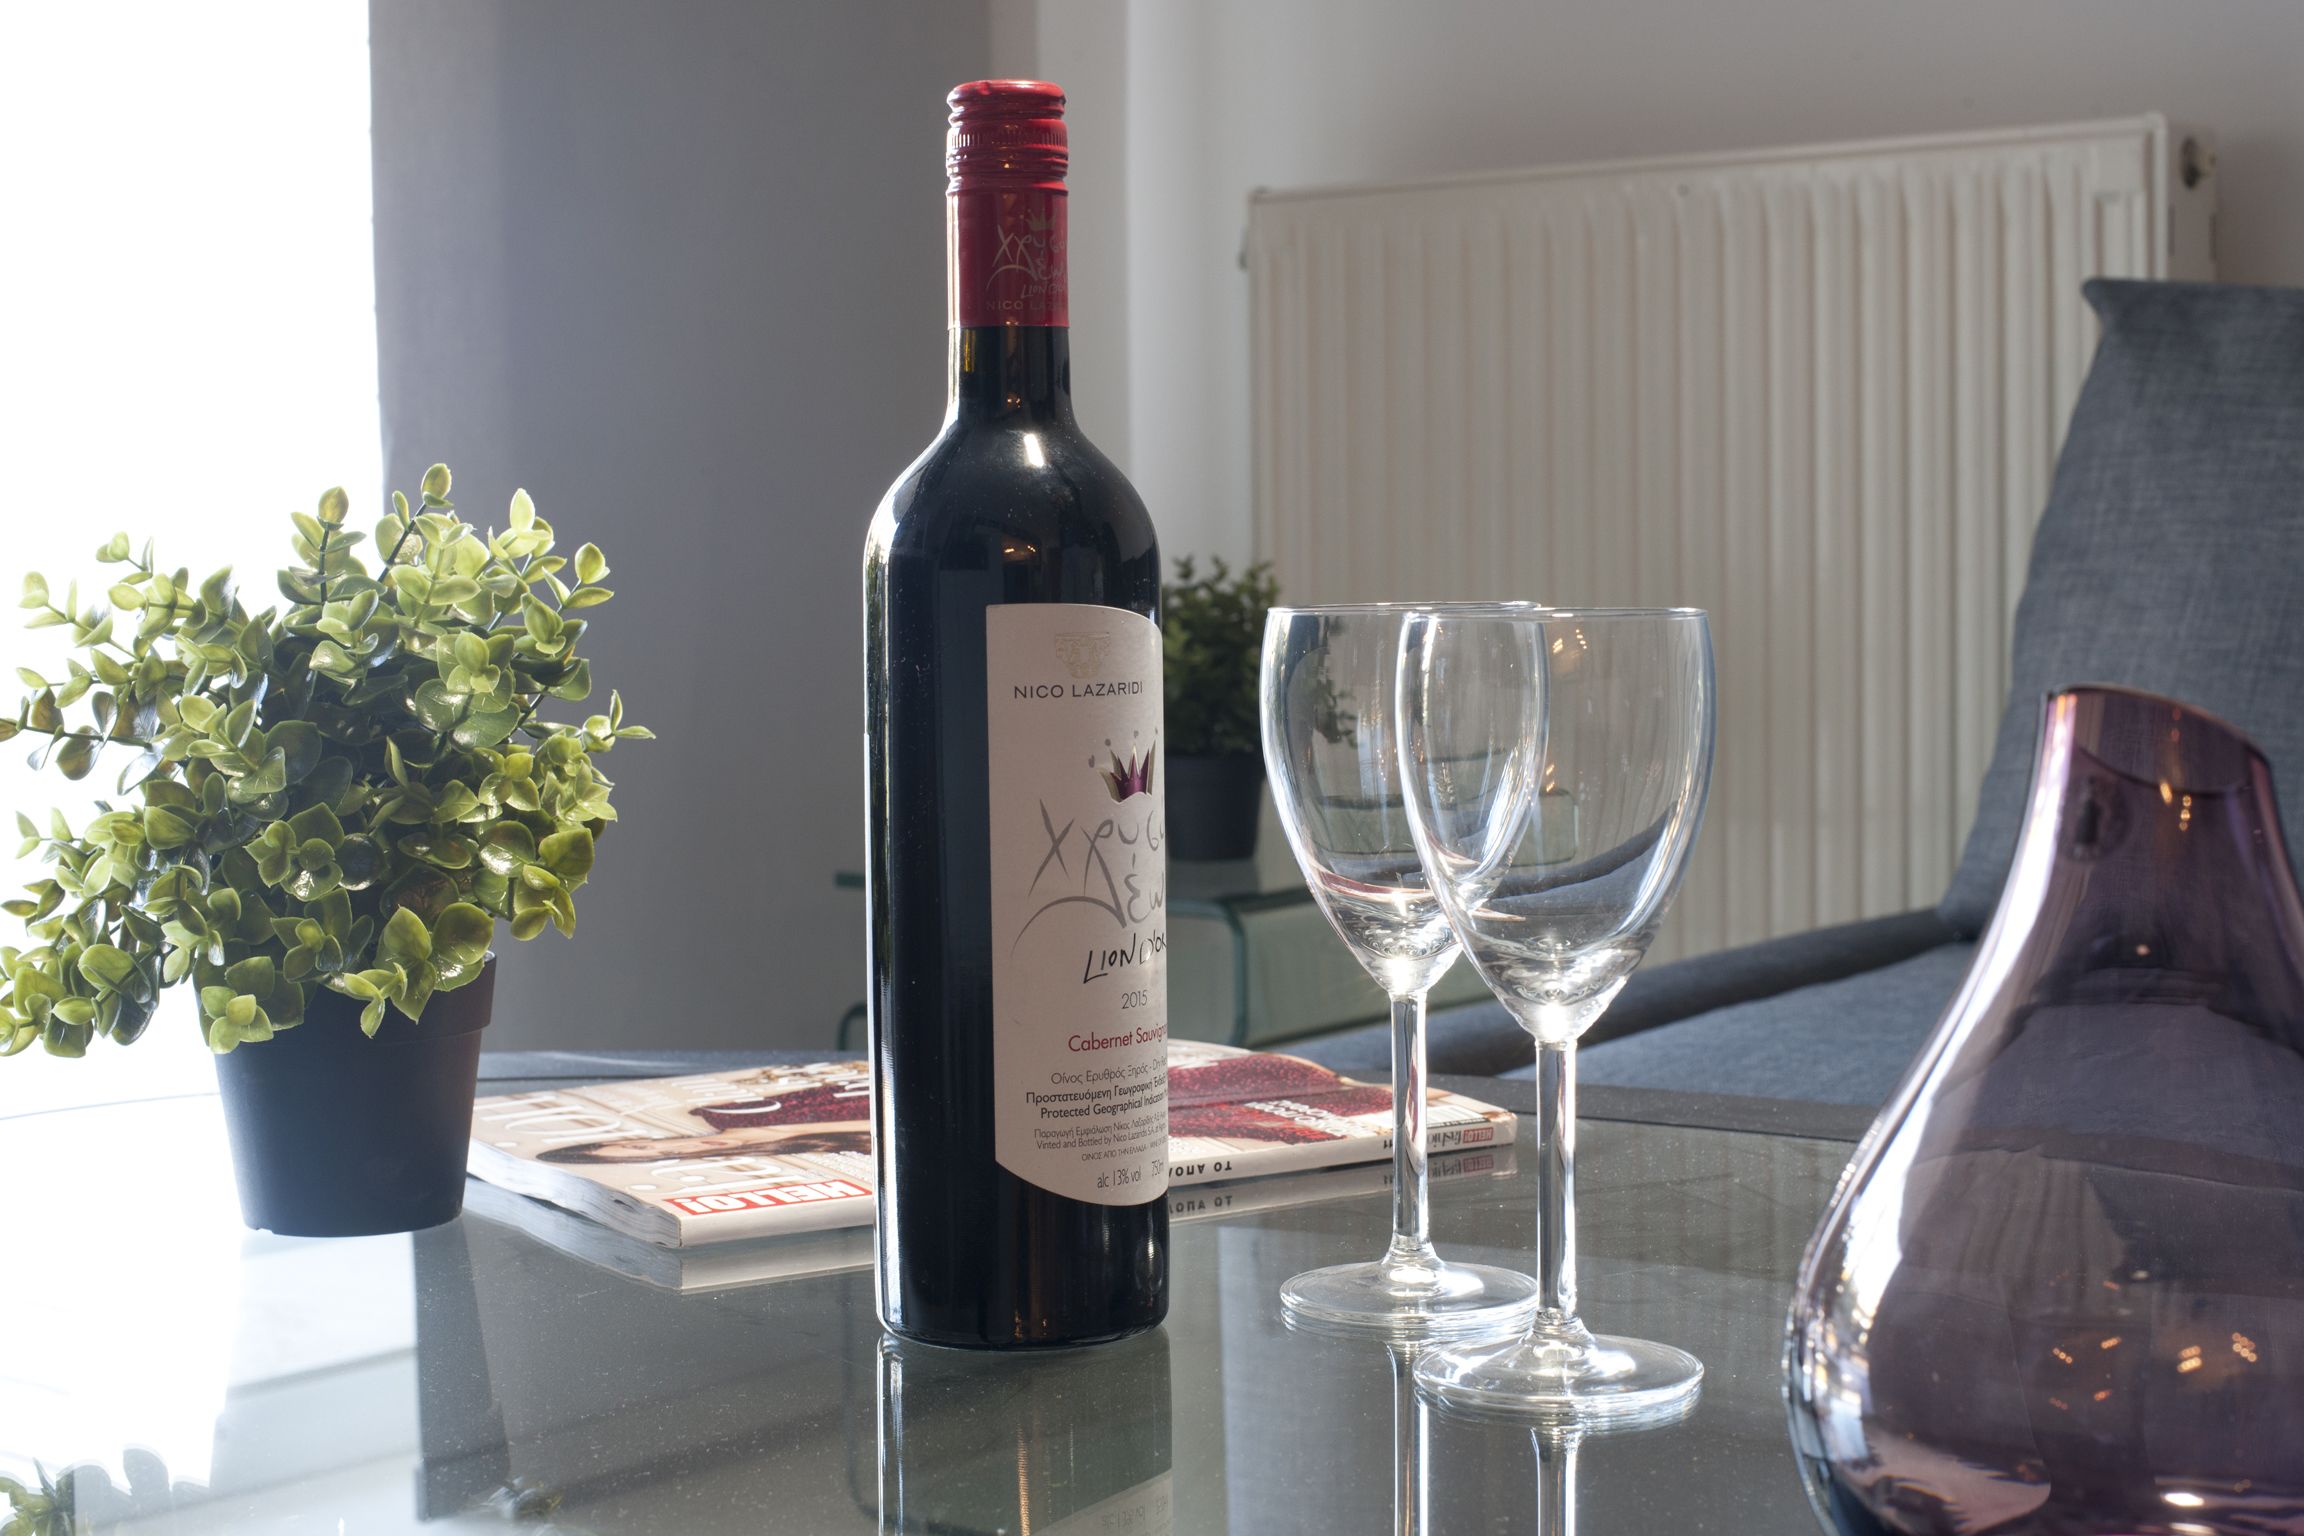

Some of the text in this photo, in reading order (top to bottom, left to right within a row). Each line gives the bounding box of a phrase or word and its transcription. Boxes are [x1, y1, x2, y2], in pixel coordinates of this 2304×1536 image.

[985, 300, 1023, 311] NICO
[1013, 681, 1143, 699] NICO LAZARIDI
[1083, 932, 1137, 984] LION
[1121, 989, 1148, 1010] 2015
[1068, 1031, 1134, 1053] Cabernet
[1051, 1072, 1084, 1085] Οίνος
[1086, 1066, 1126, 1085] Ερυθρός
[1026, 1089, 1112, 1107] Προστατευόμενη
[1041, 1105, 1091, 1119] Protected
[1093, 1096, 1143, 1116] Geographical
[1036, 1139, 1061, 1150] Vinted
[1062, 1138, 1077, 1148] and
[1078, 1134, 1103, 1148] Bottled
[1104, 1134, 1112, 1146] by
[1463, 1127, 1494, 1143] HELLO!
[1213, 1161, 1232, 1172] ΤΟ
[1097, 1171, 1110, 1189] alc
[1113, 1167, 1130, 1186] 13%
[1131, 1164, 1142, 1182] vol
[677, 1179, 866, 1214] HELLO!
